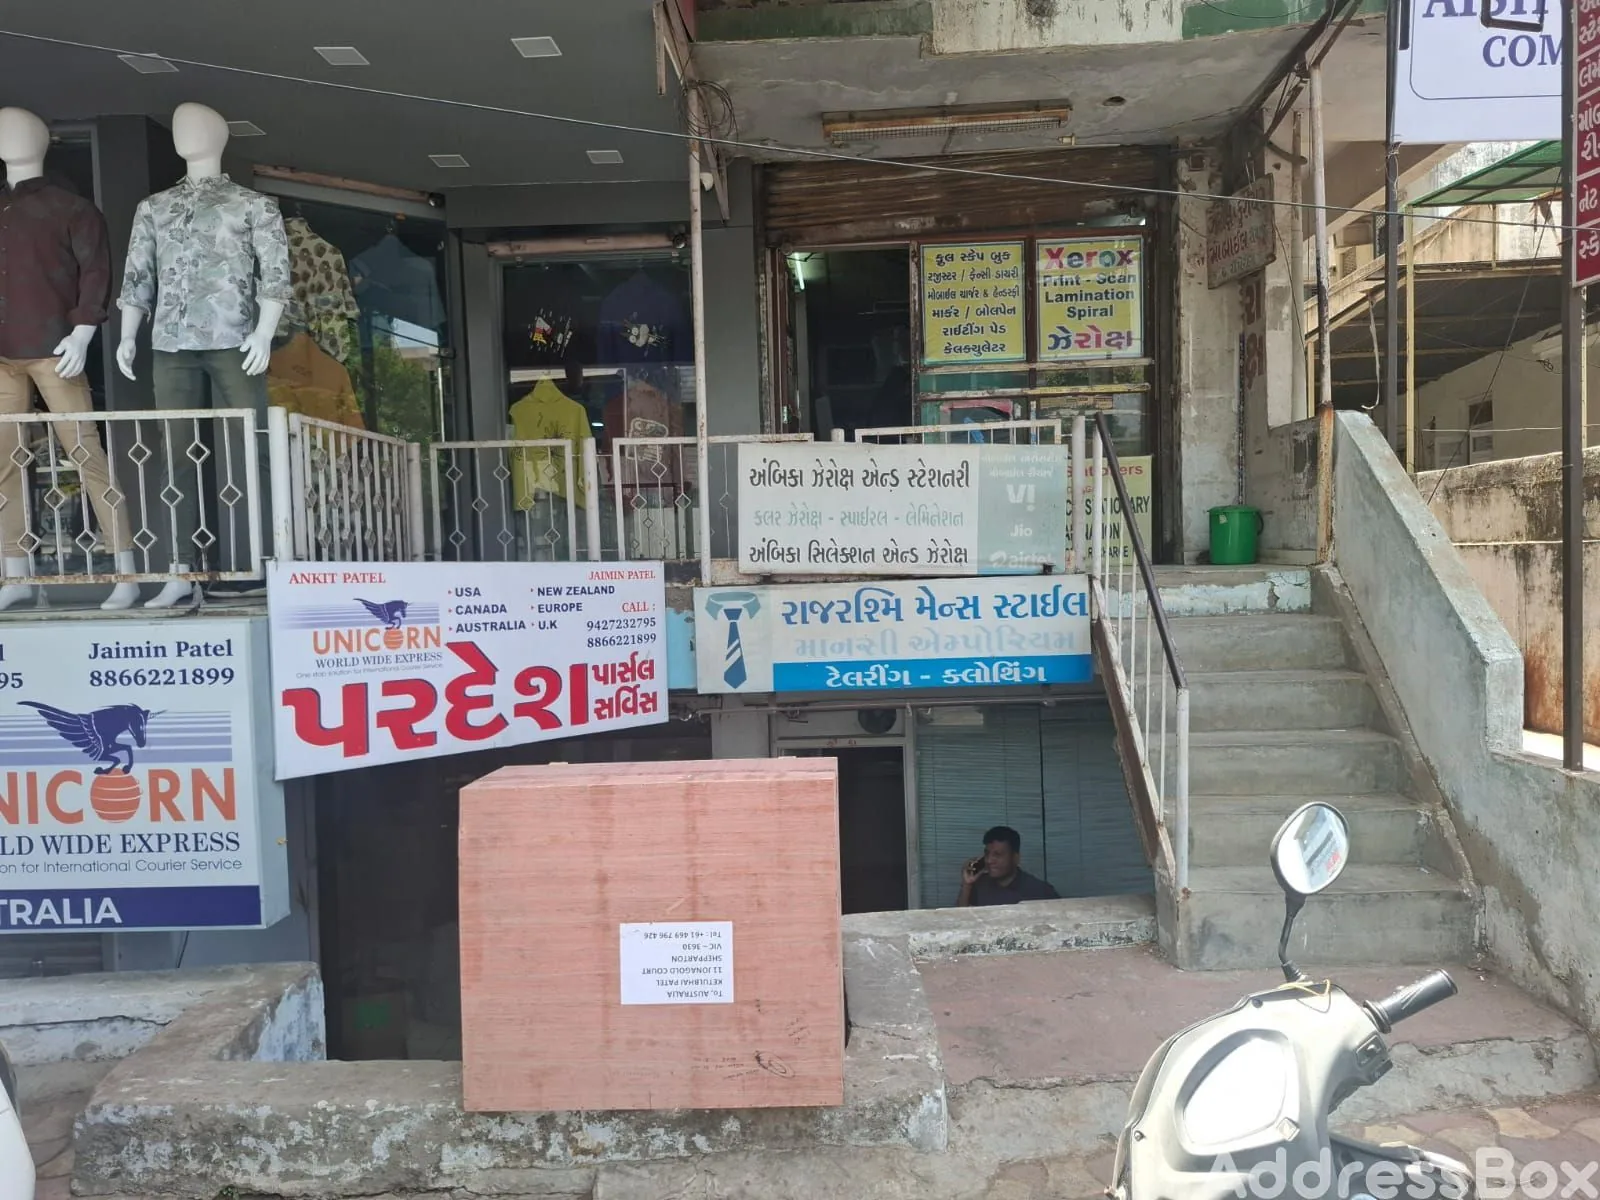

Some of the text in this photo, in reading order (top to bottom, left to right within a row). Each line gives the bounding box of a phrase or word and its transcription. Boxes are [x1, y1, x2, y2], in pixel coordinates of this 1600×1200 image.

[991, 251, 1011, 264] બુક
[1045, 247, 1134, 269] Xerox
[1043, 274, 1080, 287] Print
[1096, 272, 1137, 284] Scan
[1045, 289, 1134, 303] Lamination
[932, 305, 960, 318] માર્કર
[976, 303, 1016, 317] બોલપેન
[1067, 304, 1114, 320] Spiral
[990, 322, 1006, 334] પેડ
[1047, 325, 1132, 350] ઝેરોક્ષ
[749, 458, 803, 488] અંબિકા
[811, 458, 854, 491] ઝેરોક્ષ
[907, 458, 970, 488] સ્ટેશનરી
[754, 509, 782, 527] કલર
[787, 501, 822, 529] ઝેરોક્ષ
[1009, 524, 1032, 537] Jio
[749, 537, 800, 563] અંબિકા
[882, 538, 919, 564] એન્ડ
[926, 538, 968, 566] ઝેરોક્ષ
[289, 572, 386, 584] ANKIT PATEL
[588, 570, 656, 580] JAIMIN PATEL
[455, 587, 482, 597] USA
[537, 585, 615, 597] NEW ZEALAND
[455, 604, 507, 616] CANADA
[537, 602, 583, 614] EUROPE
[622, 602, 649, 613] CALL
[781, 584, 1089, 625] રાજરશ્મિ મેન્સ સ્ટાઈલ
[456, 620, 526, 633] AUSTRALIA
[538, 619, 558, 630] U.K
[587, 617, 656, 632] 9427232795
[313, 626, 441, 656] UNICORN
[587, 633, 657, 648] 8866221899
[88, 639, 234, 660] Jaimin Patel
[316, 652, 443, 669] WORLD WIDE EXPRESS
[592, 651, 655, 685] પાર્સલ
[89, 667, 235, 688] 8866221899
[281, 641, 590, 758] પરદેશ
[593, 684, 658, 720] સર્વિસ
[40, 834, 112, 855] WIDE
[121, 832, 240, 854] EXPRESS
[21, 861, 41, 873] for
[43, 860, 131, 873] International
[135, 859, 187, 871] Courier
[191, 858, 243, 871] Service
[671, 955, 722, 963] SHEPPARTON
[642, 967, 668, 975] COURT
[680, 978, 723, 986] KETULBHAI
[667, 990, 709, 998] AUSTRALIA
